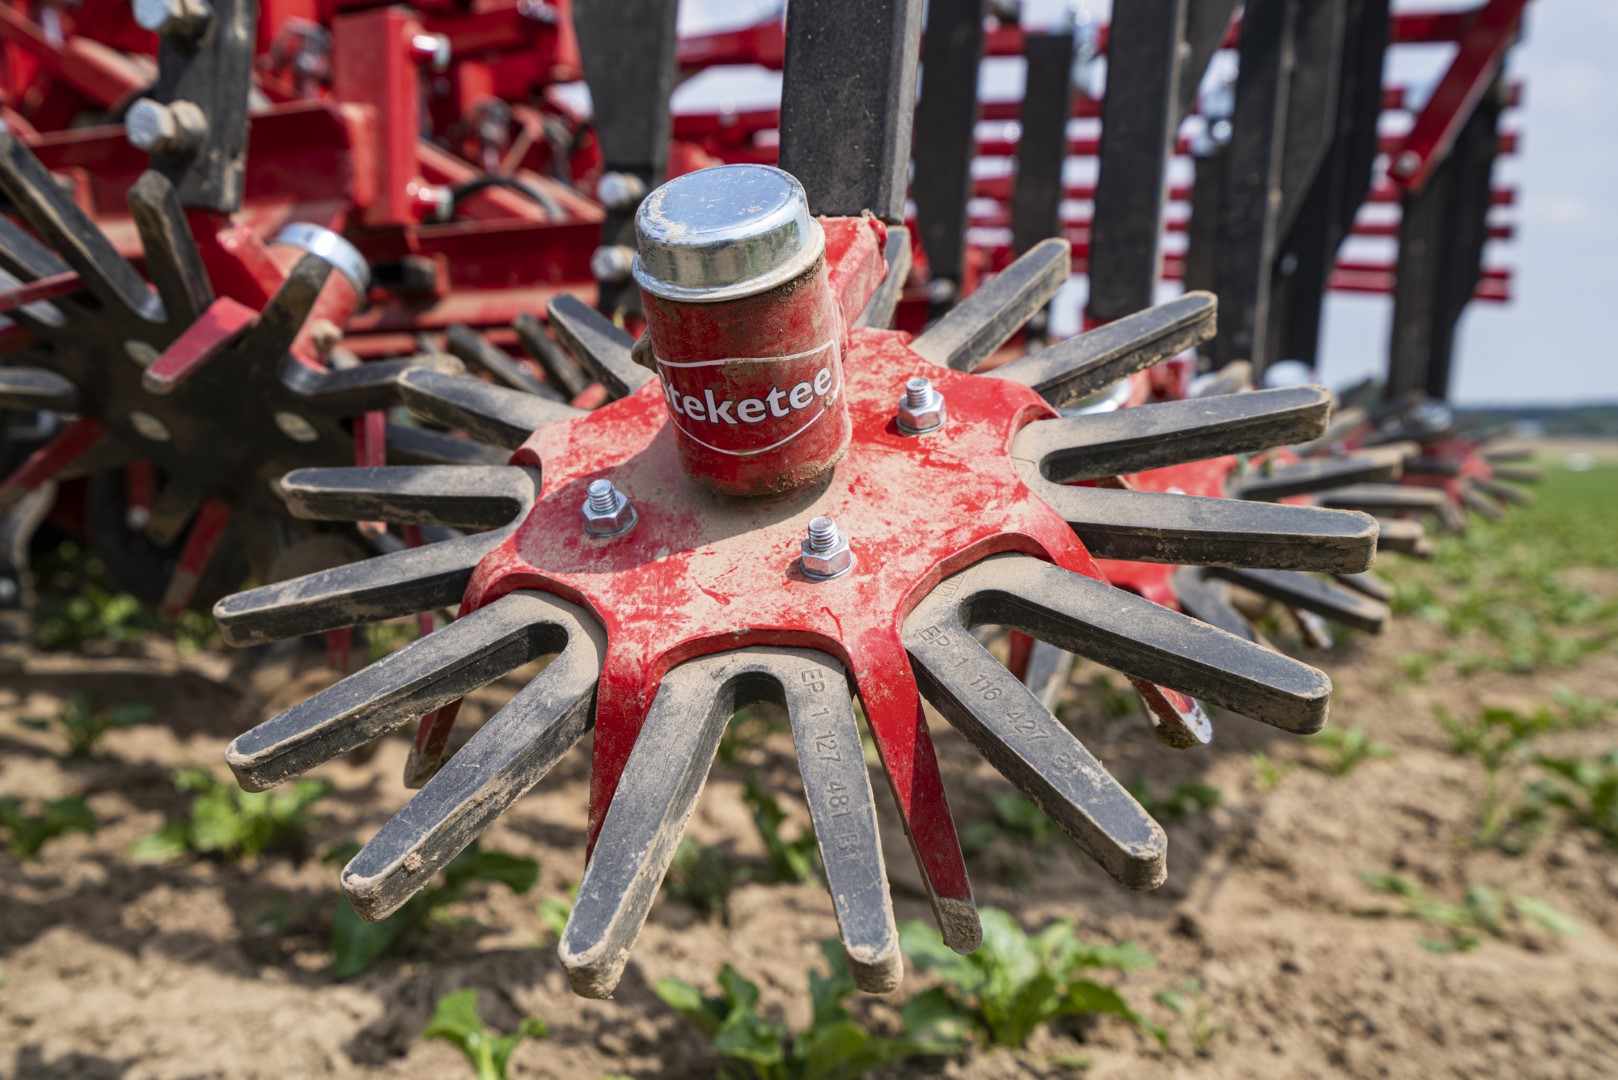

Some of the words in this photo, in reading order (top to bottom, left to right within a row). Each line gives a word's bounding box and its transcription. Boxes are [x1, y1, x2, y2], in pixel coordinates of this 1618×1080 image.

[801, 669, 825, 695] EP
[919, 626, 951, 647] EP
[954, 658, 969, 667] 1
[970, 674, 1004, 701] 116
[1007, 711, 1048, 742] 427
[812, 708, 829, 718] 1
[816, 731, 842, 763] 127
[826, 781, 851, 819] 481
